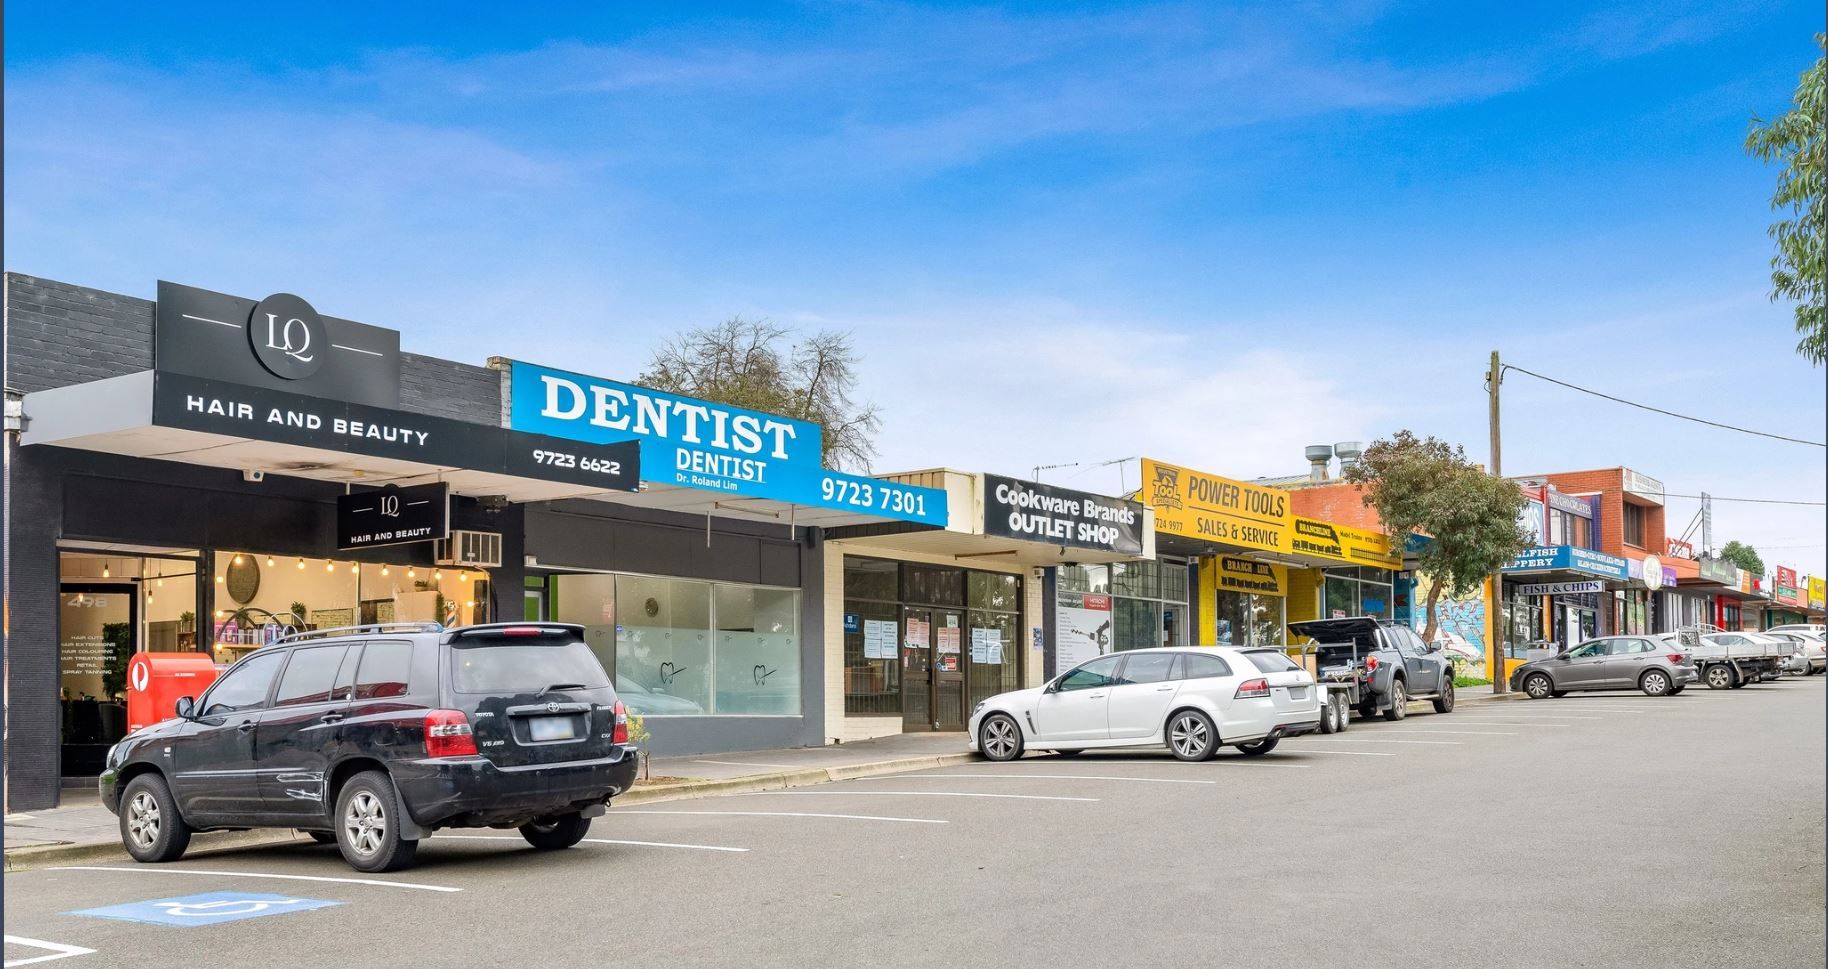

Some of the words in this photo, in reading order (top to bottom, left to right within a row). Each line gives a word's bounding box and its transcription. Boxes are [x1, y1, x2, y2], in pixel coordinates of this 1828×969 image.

[265, 313, 313, 363] LQ
[187, 395, 253, 420] HAIR
[267, 408, 321, 430] AND
[333, 418, 429, 446] BEAUTY
[540, 375, 797, 460] DENTIST
[533, 450, 575, 469] 9723
[580, 456, 620, 475] 6622
[676, 448, 767, 482] DENTIST
[676, 473, 690, 484] Dr.
[692, 475, 720, 488] Roland
[723, 480, 738, 491] Lim
[822, 477, 873, 508] 9723
[880, 487, 926, 517] 7301
[1153, 480, 1180, 500] TOOL
[1188, 475, 1240, 509] POWER
[1244, 488, 1284, 518] TOOLS
[381, 495, 399, 517] LQ
[995, 483, 1080, 516] Cookware
[1084, 499, 1135, 525] Brands
[351, 534, 371, 543] HAIR
[374, 531, 393, 541] AND
[396, 527, 431, 538] BEAUTY
[1008, 512, 1074, 539] OUTLET
[1078, 522, 1119, 546] SHOP
[1155, 517, 1167, 529] 724
[1169, 520, 1184, 532] 9977
[1197, 517, 1228, 538] SALES
[1231, 524, 1238, 540] &
[1241, 526, 1279, 547] SERVICE
[1523, 584, 1549, 594] FISH
[1552, 584, 1562, 593] &
[1563, 581, 1599, 592] CHIPS
